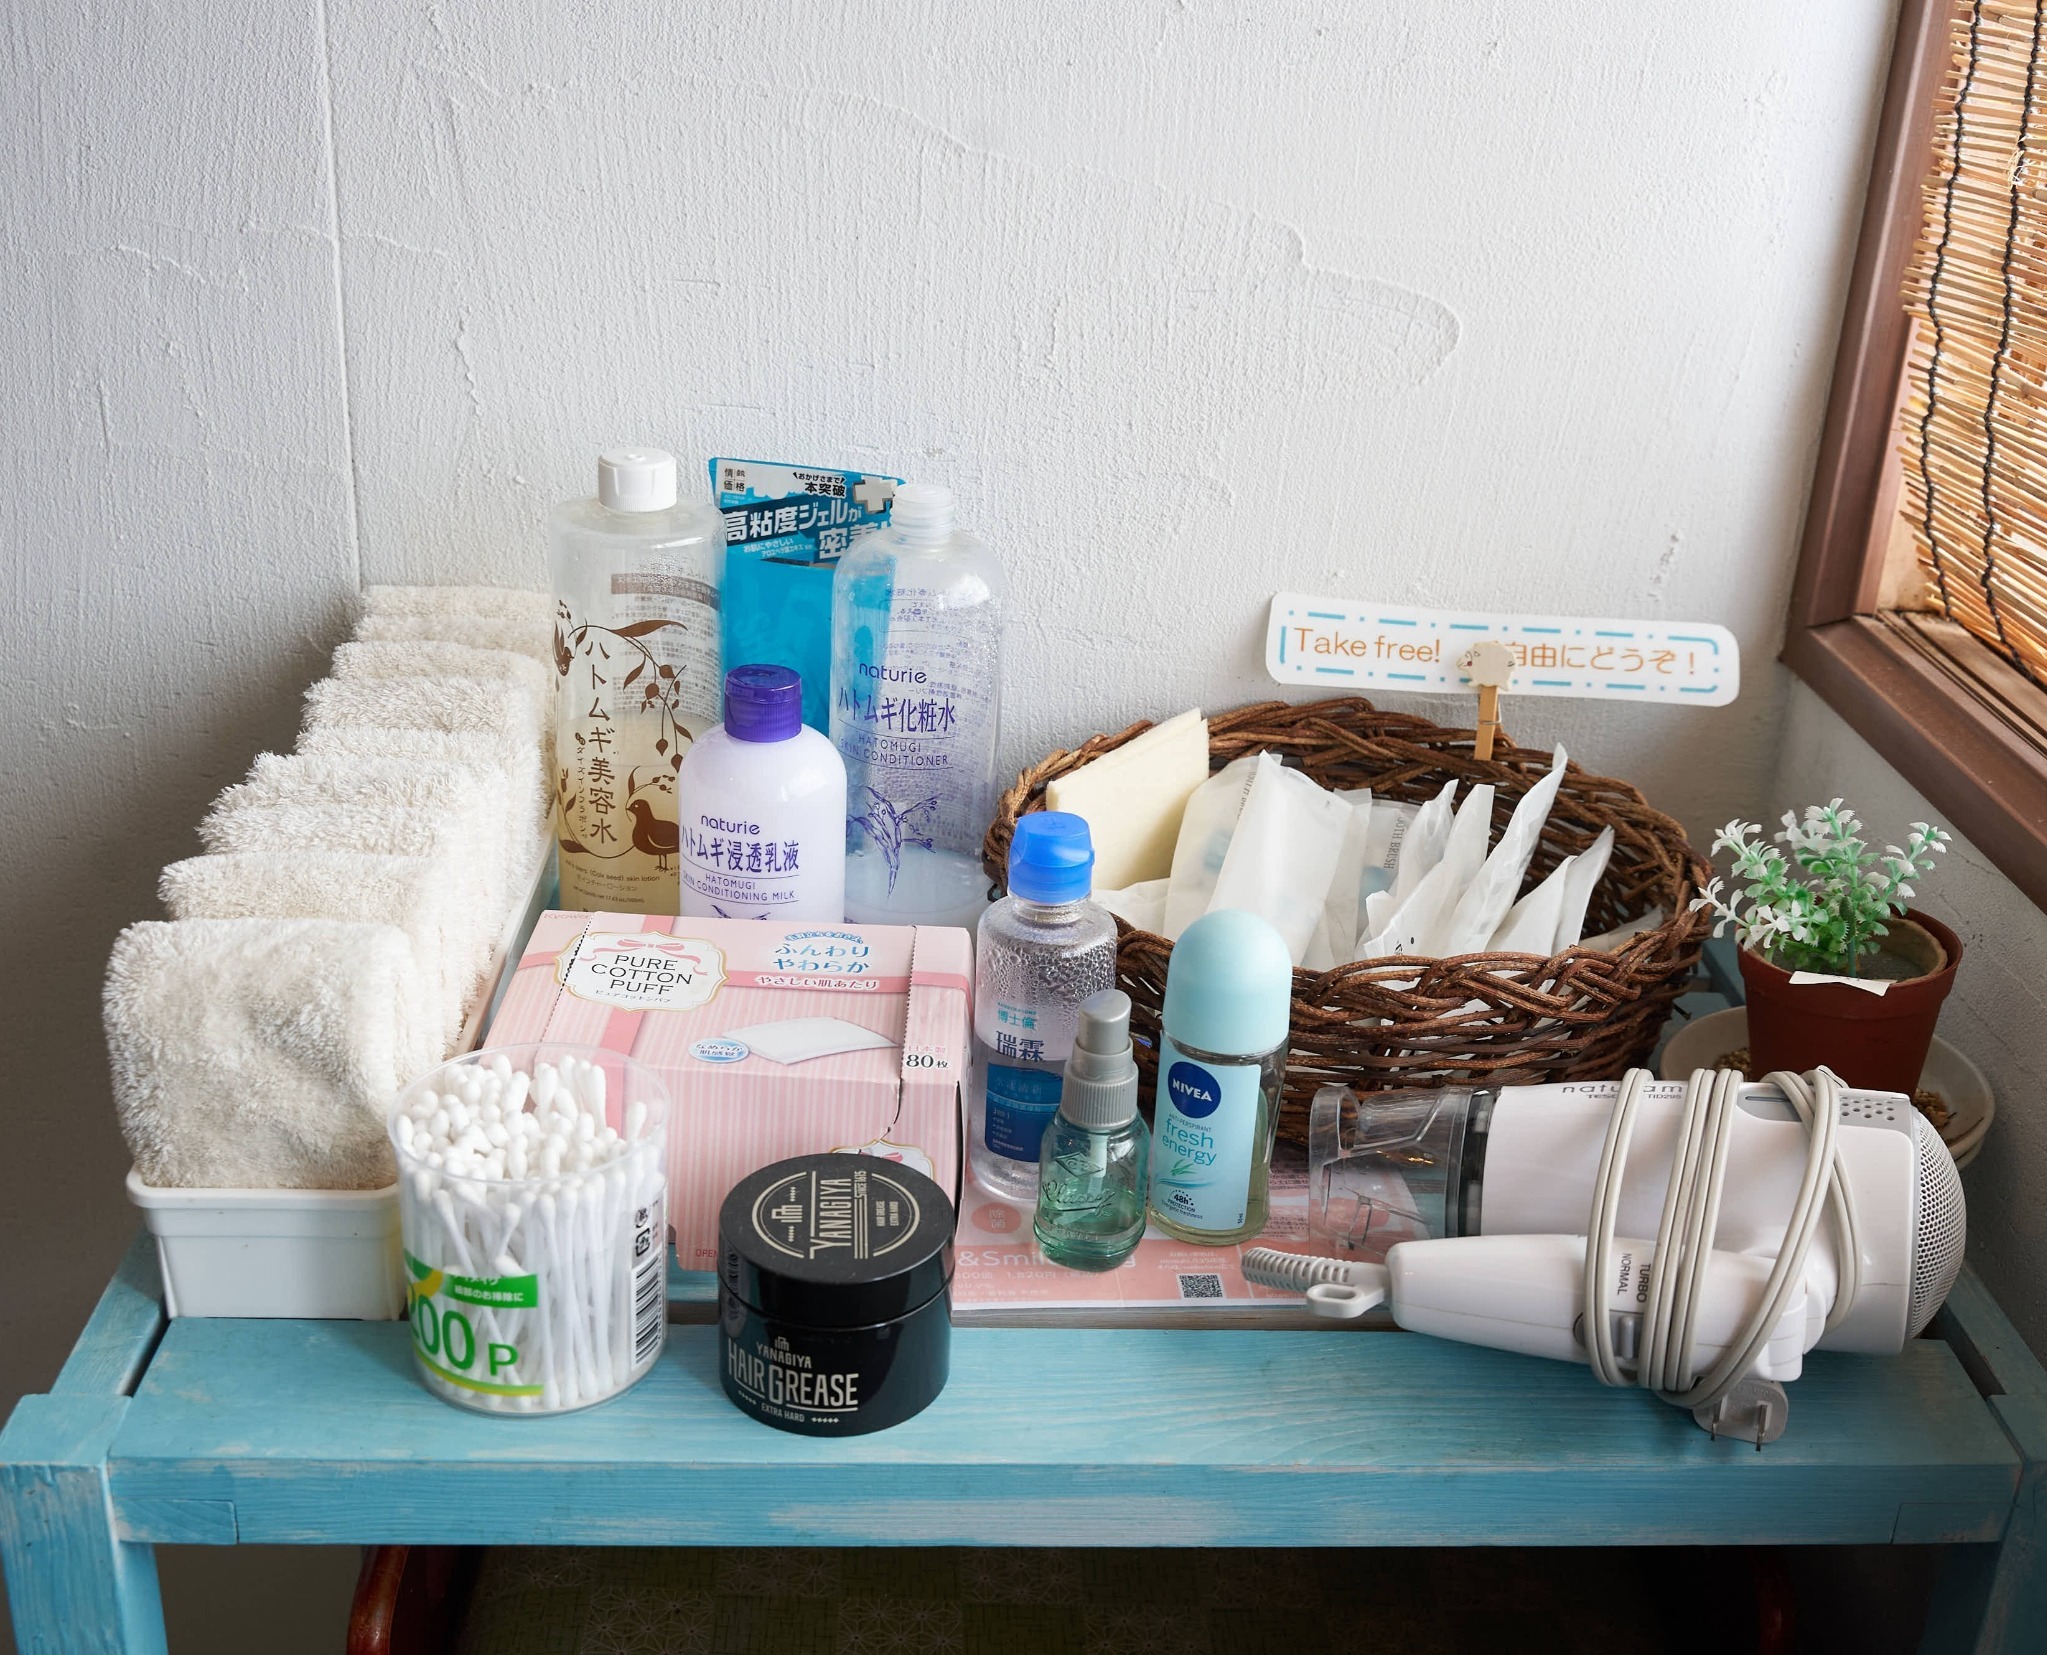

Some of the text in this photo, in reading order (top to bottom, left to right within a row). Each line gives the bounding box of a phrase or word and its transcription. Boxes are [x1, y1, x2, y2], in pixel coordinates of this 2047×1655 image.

[798, 473, 840, 484] おかげさまで
[805, 482, 846, 497] 本突破
[725, 500, 862, 541] 高粘度ジェルが
[1294, 627, 1440, 663] Take free!
[1505, 642, 1695, 675] 自由にどうぞ！
[859, 663, 927, 684] naturie
[839, 687, 956, 734] ハトムギ化粧水
[585, 641, 617, 844] ハトムギ美容水
[840, 738, 948, 766] SKIN CONDITIONER
[858, 735, 921, 753] HATOMUGI
[701, 815, 760, 835] naturie
[681, 825, 799, 873] ハトムギ浸透乳液
[1384, 842, 1401, 869] BRUSH
[641, 874, 660, 882] lotion
[683, 871, 695, 886] SKIN
[697, 880, 768, 901] CONDITIONING
[772, 891, 795, 901] MILK
[705, 873, 756, 890] HATOMUGI
[775, 943, 869, 958] ふんわり
[614, 954, 678, 971] PURE
[773, 958, 870, 973] やわらか
[591, 963, 693, 985] COTTON
[759, 976, 877, 990] やさしい肌あたり
[595, 989, 671, 1003] ピュアコットンパフ
[610, 979, 674, 995] PUFF
[996, 1031, 1044, 1062] 瑞霖
[906, 1054, 948, 1068] 80枚
[1172, 1078, 1212, 1102] NIVEA
[1562, 1084, 1683, 1093] natuam
[1166, 1118, 1214, 1149] fresh
[1162, 1135, 1217, 1166] energy
[1168, 1198, 1196, 1213] PROTECTION
[1173, 1194, 1189, 1205] 48h
[810, 1178, 852, 1260] YANAGIYA
[1617, 1253, 1632, 1295] NORMAL
[1636, 1263, 1651, 1303] TURBO
[757, 1341, 812, 1369] YANAGIYA
[728, 1337, 859, 1407] HAIR GREASE
[761, 1402, 805, 1423] EXTRA HARD
